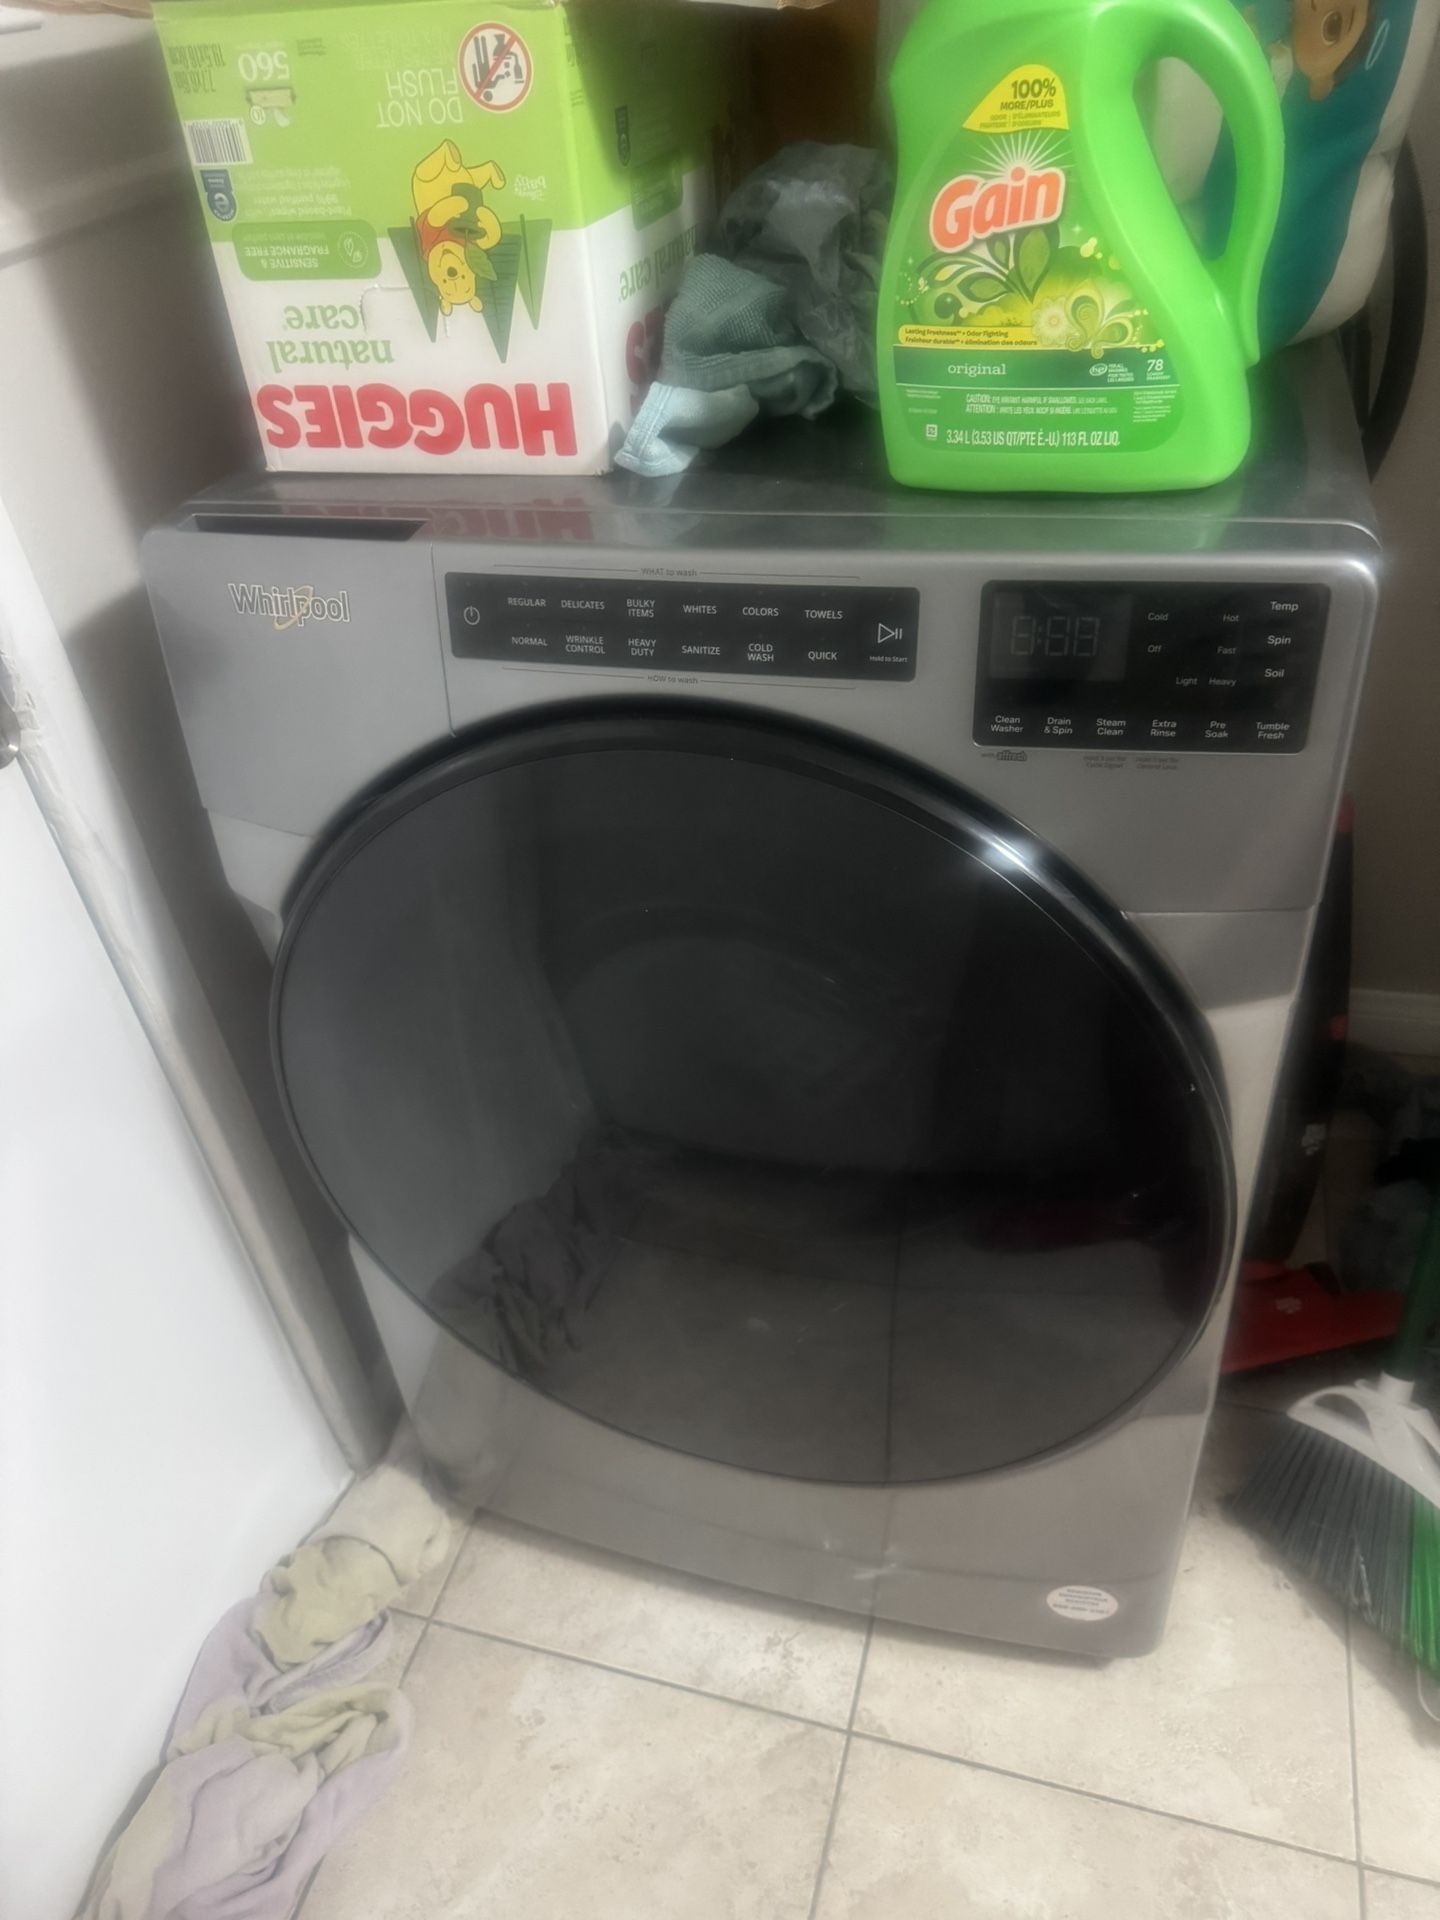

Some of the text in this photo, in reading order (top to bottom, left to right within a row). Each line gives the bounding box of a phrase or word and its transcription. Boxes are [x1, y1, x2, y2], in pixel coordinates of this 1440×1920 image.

[238, 50, 290, 81] 560
[385, 67, 459, 97] FLUSH
[1011, 77, 1057, 99] 100%
[1000, 99, 1054, 111] MORE/PLUS
[376, 96, 463, 127] DO NOT
[930, 165, 1065, 252] Gain
[244, 245, 330, 256] FRAGRANCE FREE
[270, 258, 319, 269] SENSITIVE
[283, 304, 361, 330] care
[266, 339, 396, 374] natural
[947, 363, 1007, 377] original
[1147, 358, 1164, 372] 78
[256, 382, 578, 456] HUGGIES
[947, 429, 964, 444] 3.34
[965, 430, 970, 444] L
[971, 429, 993, 446] (3.53
[993, 430, 1004, 445] US
[1006, 430, 1036, 446] QT/PTE
[1062, 430, 1076, 446] 113
[1078, 431, 1089, 446] FL
[1090, 431, 1102, 446] OZ
[640, 568, 664, 576] WHAT
[676, 569, 698, 577] wash
[227, 583, 351, 627] Whirlpool
[507, 597, 546, 607] REGULAR
[561, 599, 605, 609] DELICATES
[626, 599, 655, 608] BULKY
[1270, 601, 1299, 613] Temp
[628, 608, 655, 618] ITEMS
[683, 604, 717, 614] WHITES
[742, 606, 779, 617] COLORS
[804, 609, 843, 619] TOWELS
[1147, 612, 1169, 622] Cold
[1222, 613, 1240, 623] Hot
[511, 636, 548, 647] NORMAL
[565, 635, 604, 645] WRINKLE
[628, 638, 656, 647] HEAVY
[1267, 635, 1292, 648] Spin
[565, 644, 606, 654] CONTROL
[631, 647, 655, 657] DUTY
[681, 645, 721, 655] SANITIZE
[748, 643, 773, 652] COLD
[1147, 645, 1163, 654] Off
[1217, 646, 1237, 655] Fast
[747, 652, 774, 662] WASH
[807, 651, 838, 661] QUICK
[1264, 668, 1285, 679] Soil
[1175, 676, 1198, 687] Light
[1208, 677, 1237, 688] Heavy
[995, 715, 1021, 725] Clean
[1046, 717, 1072, 726] Drain
[1096, 718, 1127, 728] Steam
[1152, 719, 1177, 729] Extra
[1210, 720, 1226, 730] Pre
[990, 724, 1024, 734] Washer
[1044, 726, 1073, 736] & Spin
[1097, 727, 1124, 736] Clean
[1255, 722, 1290, 731] Tumble
[1150, 728, 1176, 738] Rinse
[1205, 729, 1229, 739] Soak
[1257, 730, 1285, 740] Fresh
